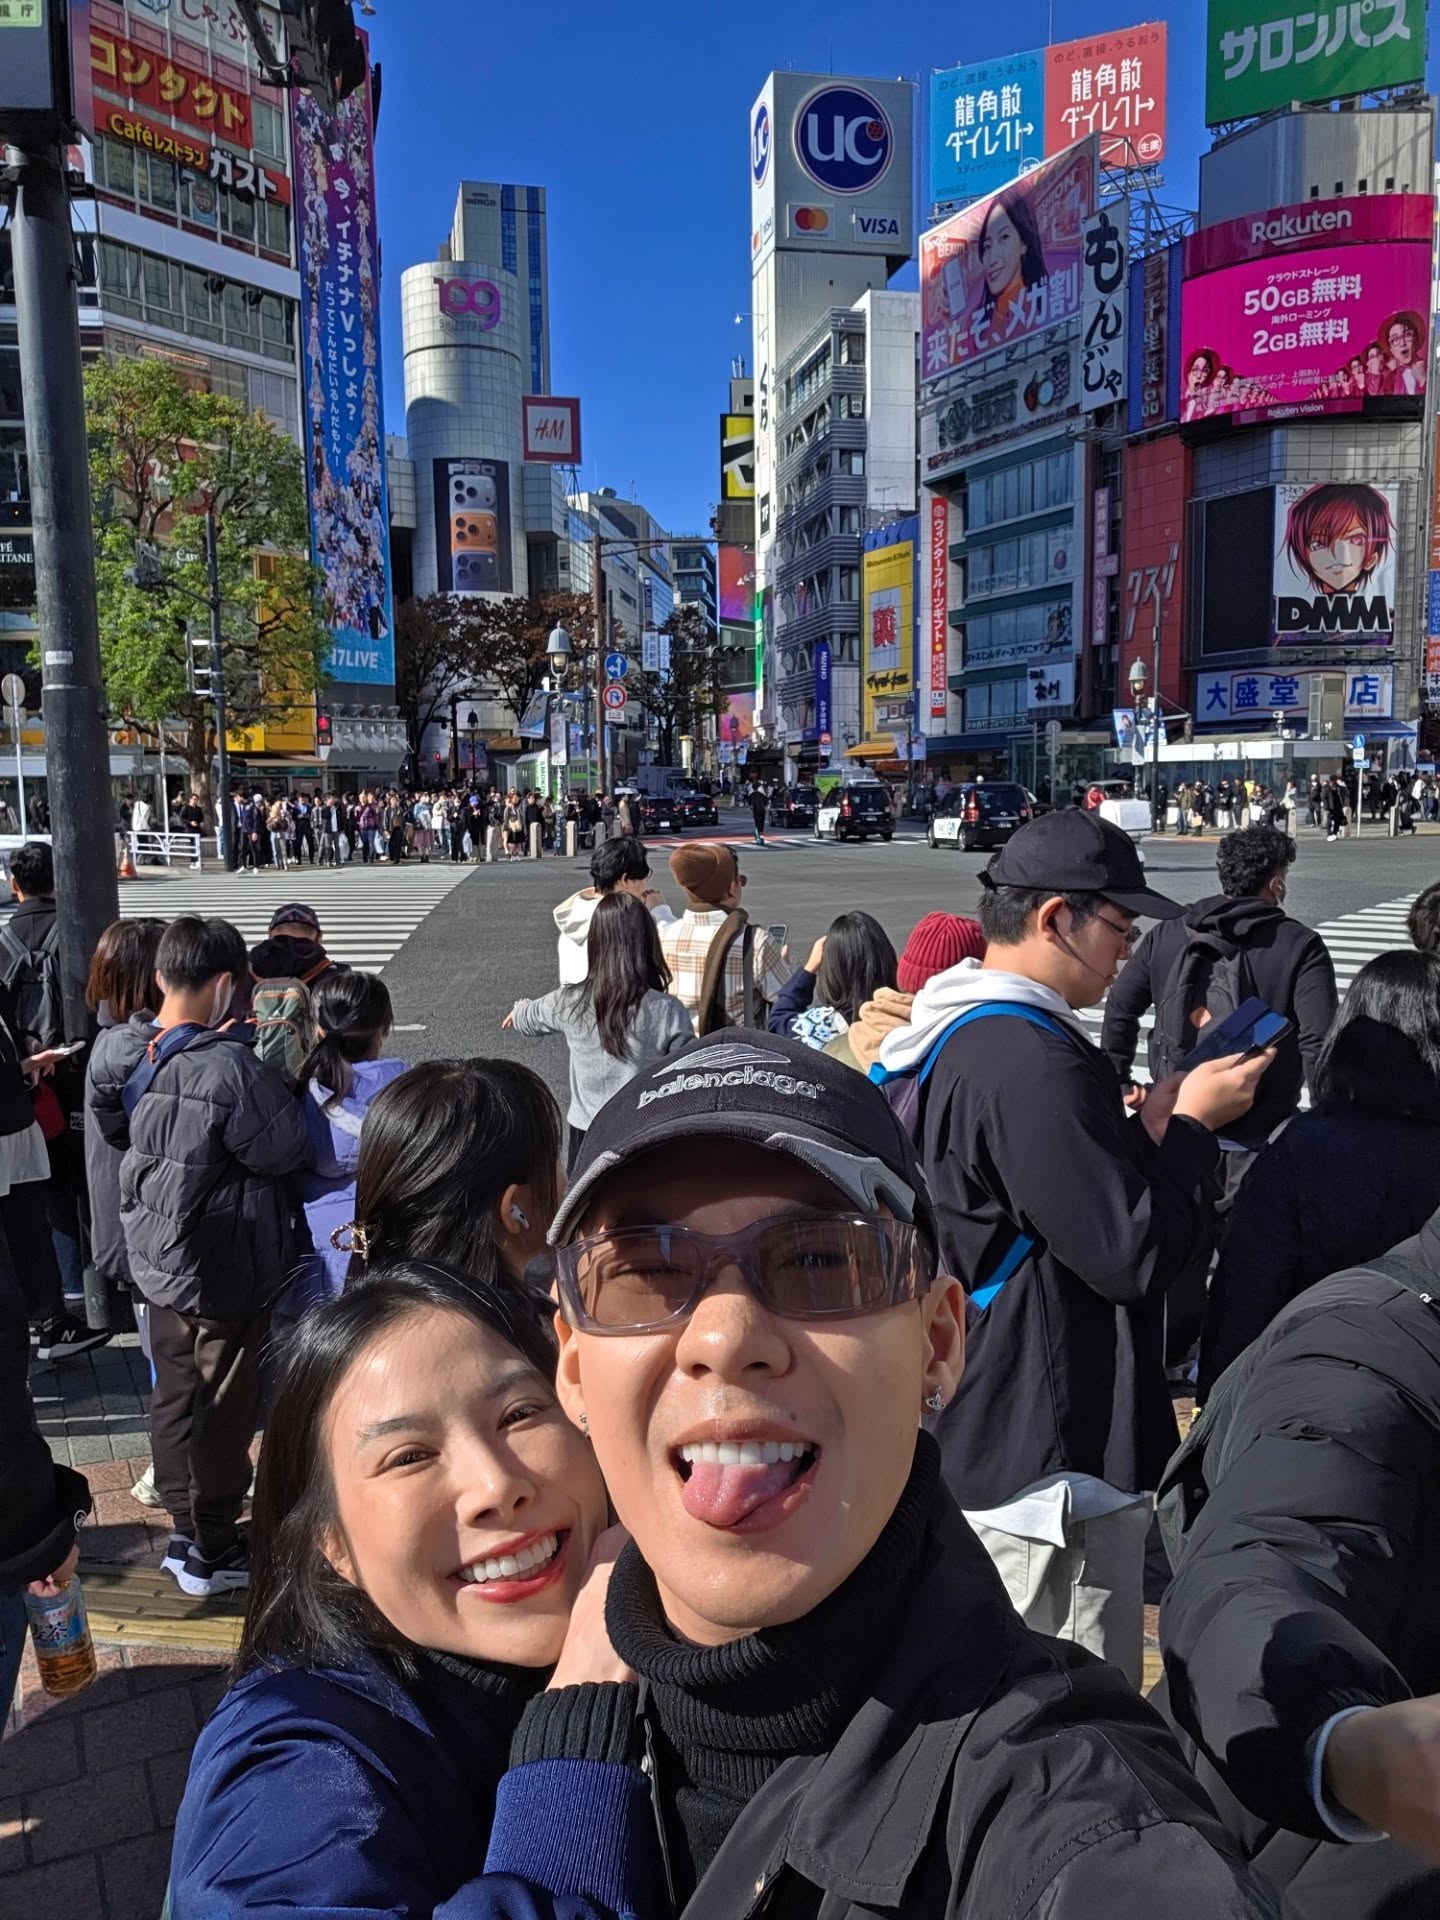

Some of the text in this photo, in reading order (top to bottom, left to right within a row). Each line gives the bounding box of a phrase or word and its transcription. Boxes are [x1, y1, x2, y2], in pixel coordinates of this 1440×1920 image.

[1220, 0, 1411, 81] サロンパス
[90, 34, 245, 129] コンタクト
[1071, 56, 1142, 103] 龍角散
[954, 83, 1021, 128] 龍角散
[1061, 94, 1155, 138] ダイレクト
[945, 119, 1034, 162] ダイレクト
[210, 148, 277, 199] ガスト
[858, 218, 899, 234] VISA
[1252, 209, 1352, 244] Rakuten
[1244, 274, 1362, 315] 50GB無料
[1267, 265, 1339, 284] クラウドストレージ
[926, 261, 1079, 373] 来たぞ、メガ割
[1084, 213, 1124, 398] もんじゃ
[1253, 318, 1349, 355] 2GB無料
[536, 419, 565, 440] H&M
[448, 463, 496, 476] PRO
[933, 519, 945, 642] ウィンターフルーツギフト
[1125, 540, 1178, 641] クスリ
[1276, 595, 1391, 631] DMM
[331, 649, 378, 668] 17LIVE
[1206, 675, 1379, 711] 大盛堂店
[539, 761, 547, 799] SMOKIN
[637, 1066, 817, 1109] balenciaga
